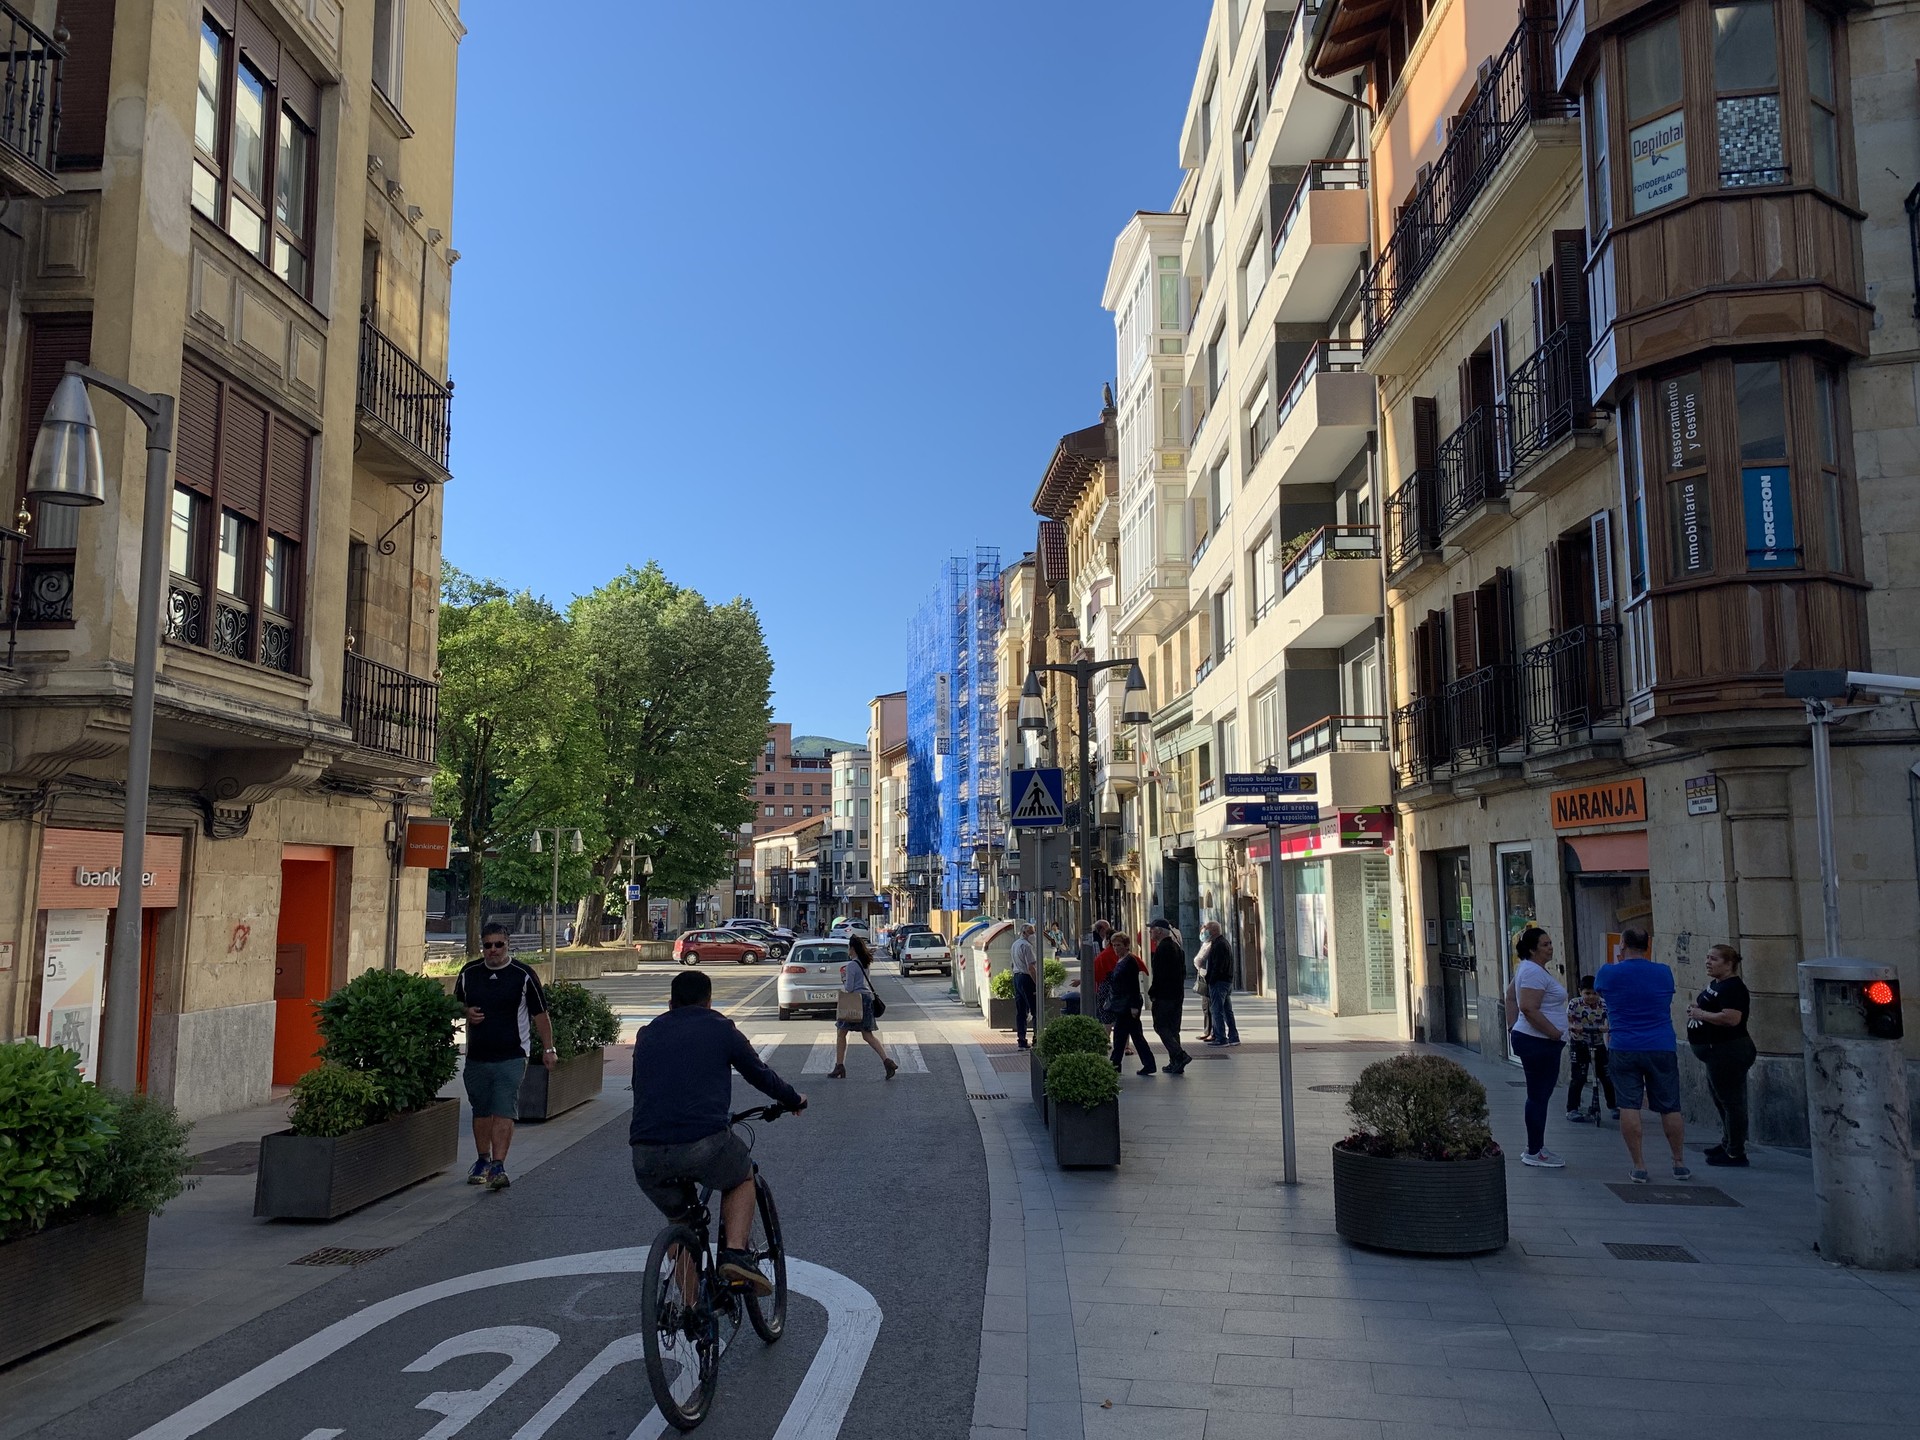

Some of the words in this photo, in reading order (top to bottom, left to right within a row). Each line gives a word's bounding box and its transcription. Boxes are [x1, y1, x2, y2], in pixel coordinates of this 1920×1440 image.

[1633, 121, 1684, 158] Depitotal
[1633, 167, 1687, 193] FOTODEPILACION
[1648, 183, 1673, 199] LASER
[1668, 382, 1683, 467] Asesoramiento
[1683, 393, 1698, 440] Gestión
[1683, 484, 1699, 570] Inmobiliaria
[1256, 775, 1283, 783] bulegoa
[1282, 814, 1317, 822] exposiciones
[1557, 786, 1637, 822] NARANJA
[77, 865, 157, 886] banker.
